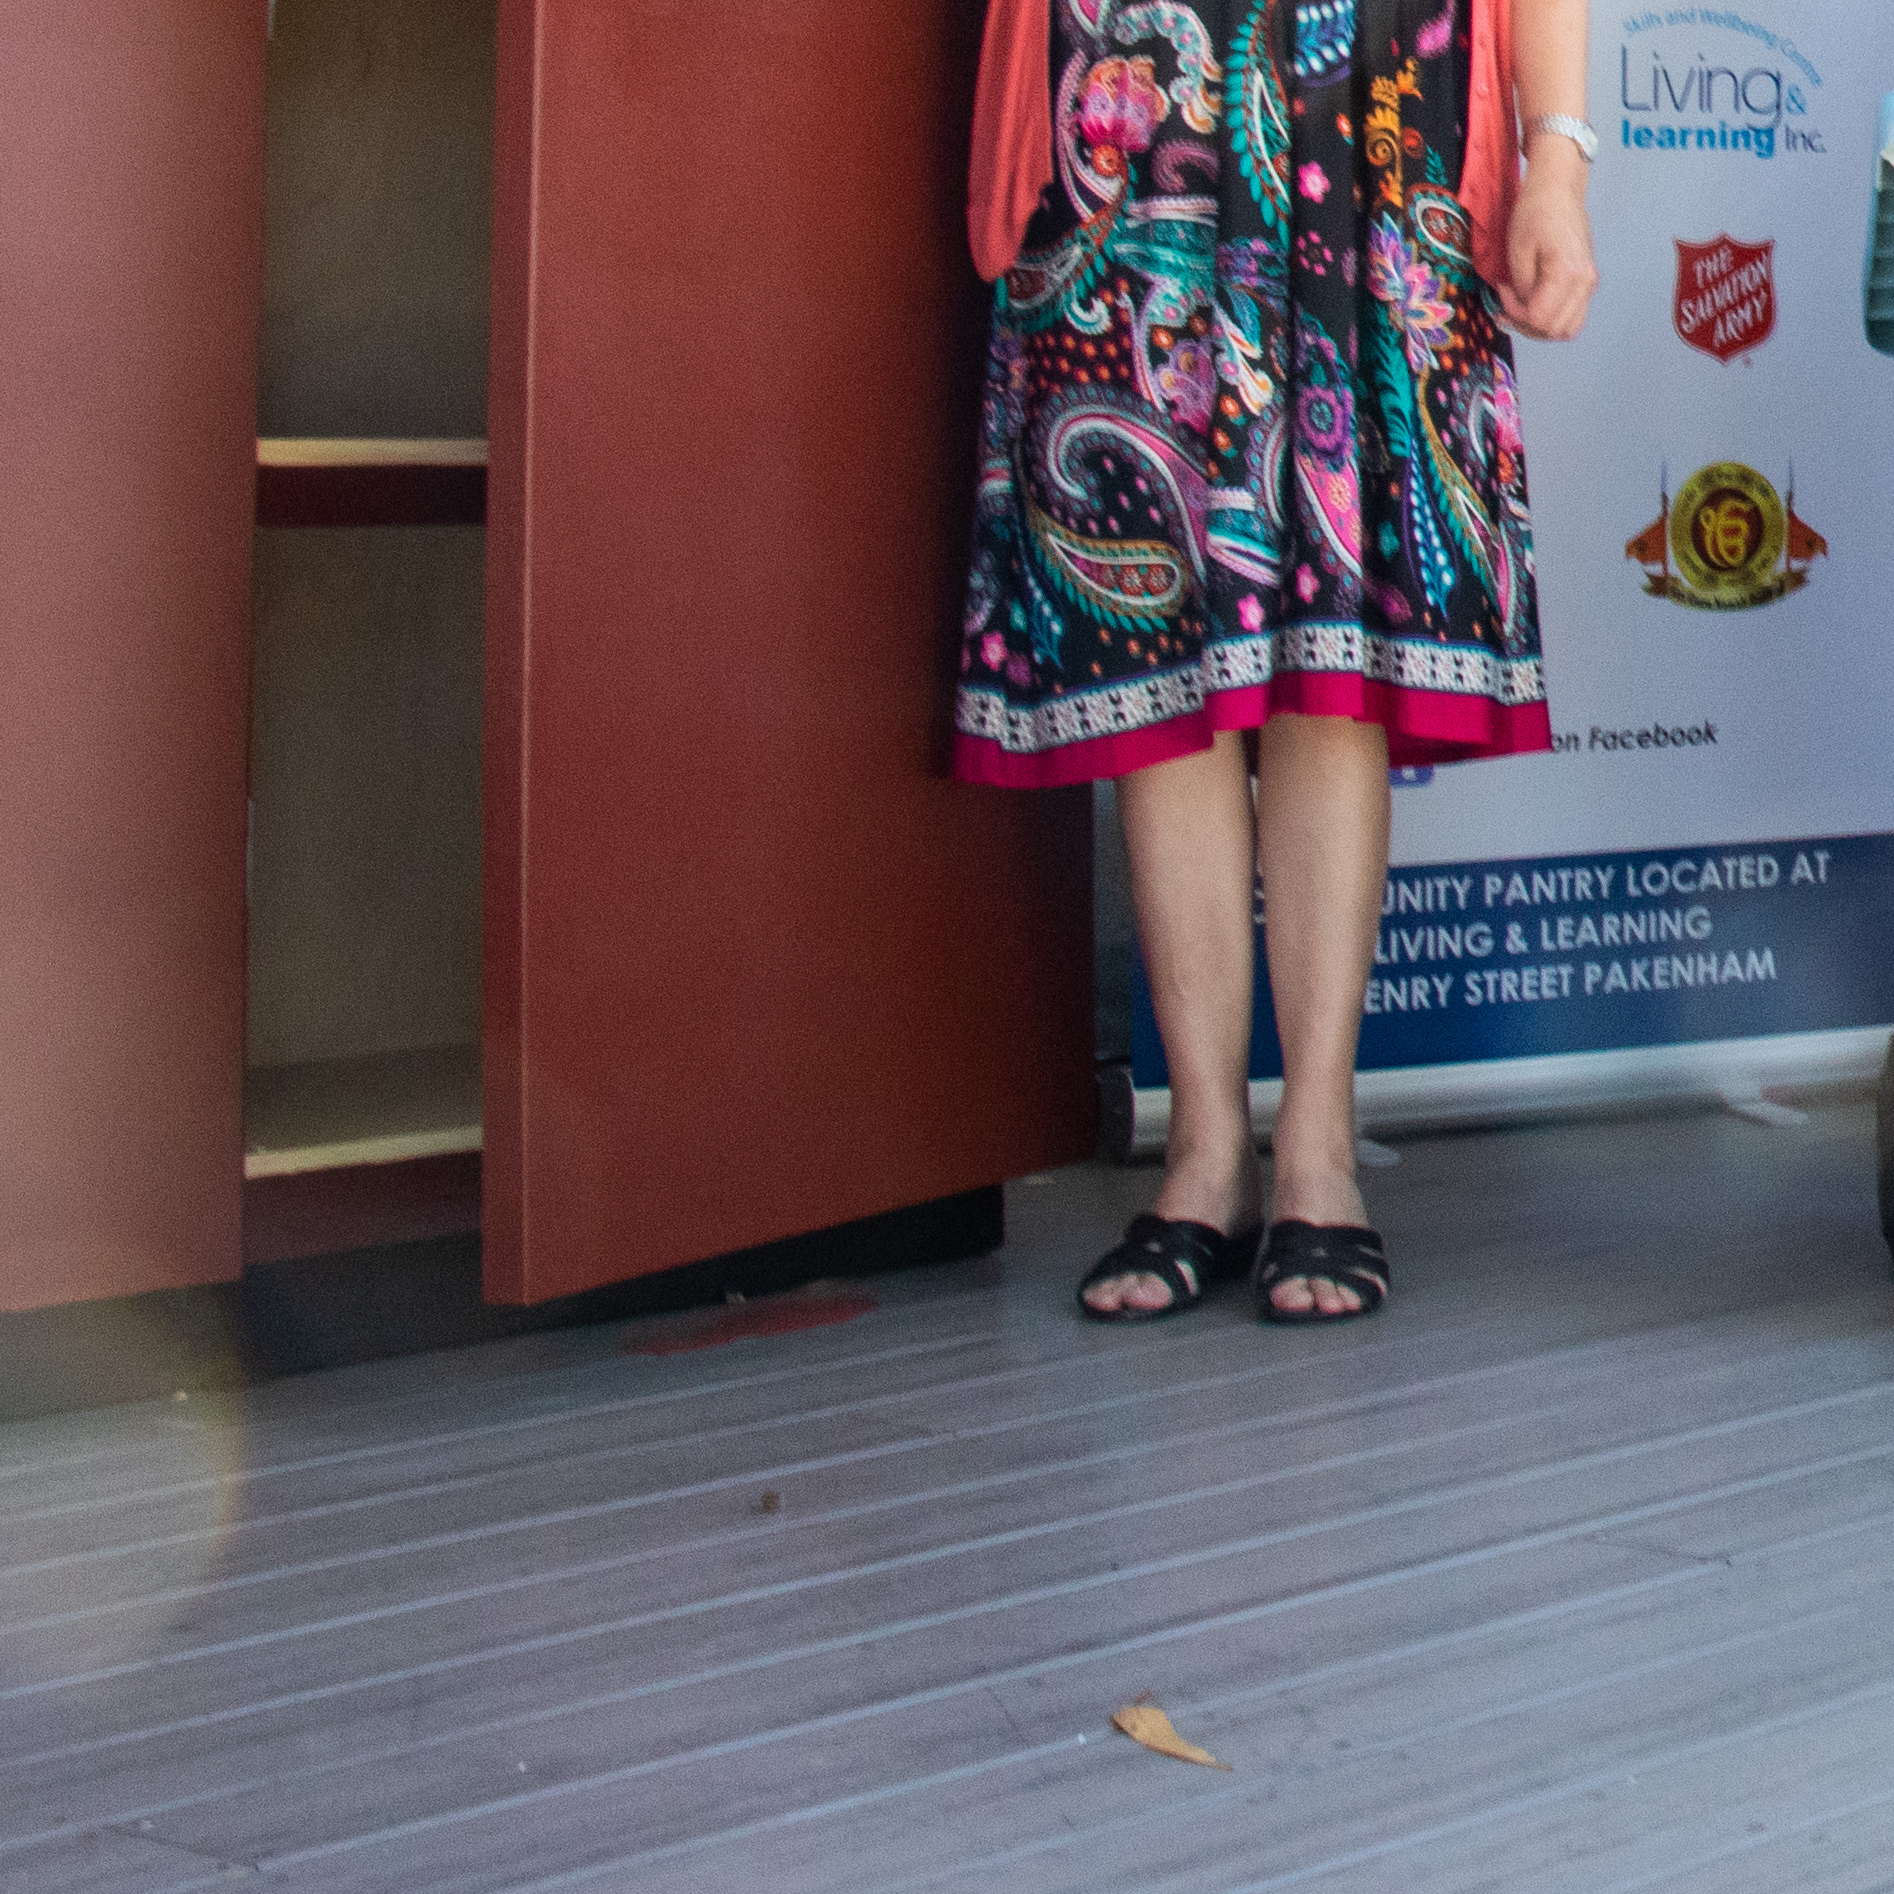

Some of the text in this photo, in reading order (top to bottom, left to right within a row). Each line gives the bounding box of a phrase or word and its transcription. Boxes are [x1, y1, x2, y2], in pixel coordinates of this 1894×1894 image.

[1620, 42, 1783, 132] Living
[1620, 117, 1775, 159] learning
[1587, 719, 1720, 752] Facebook
[1483, 863, 1617, 907] PANTRY
[1626, 855, 1780, 899] LOCATED
[1790, 849, 1833, 885] AT
[1374, 905, 1715, 966] LIVING & LEARNING
[1363, 946, 1778, 1016] ENRY STREET PAKENHAM
